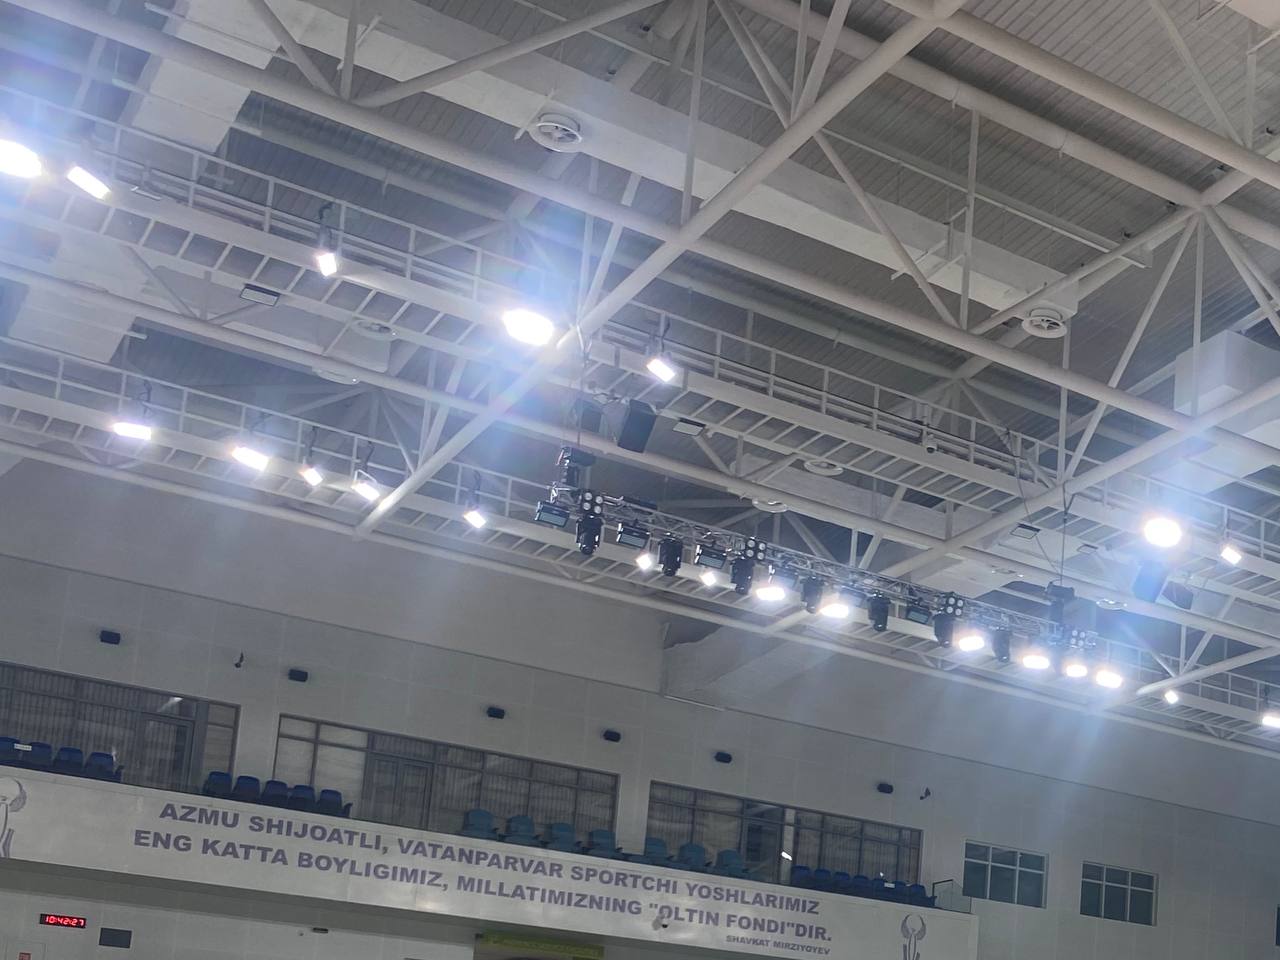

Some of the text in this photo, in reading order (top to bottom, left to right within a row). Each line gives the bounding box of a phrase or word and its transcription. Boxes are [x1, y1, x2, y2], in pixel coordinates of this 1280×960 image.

[134, 829, 192, 853] ENG
[202, 838, 289, 866] KATTA
[298, 852, 448, 892] BOYLIGIMIZ,
[457, 875, 642, 915] MILLATIMIZNING
[726, 914, 832, 942] FONDI"DIR.
[160, 803, 820, 915] AZMU SHIJOATLI, VATANPARVAR SPORTCHI YOSHLARIMIZ
[45, 915, 85, 926] 10:42:27
[726, 935, 831, 955] SHAVKAT MIRZIYOYEV
